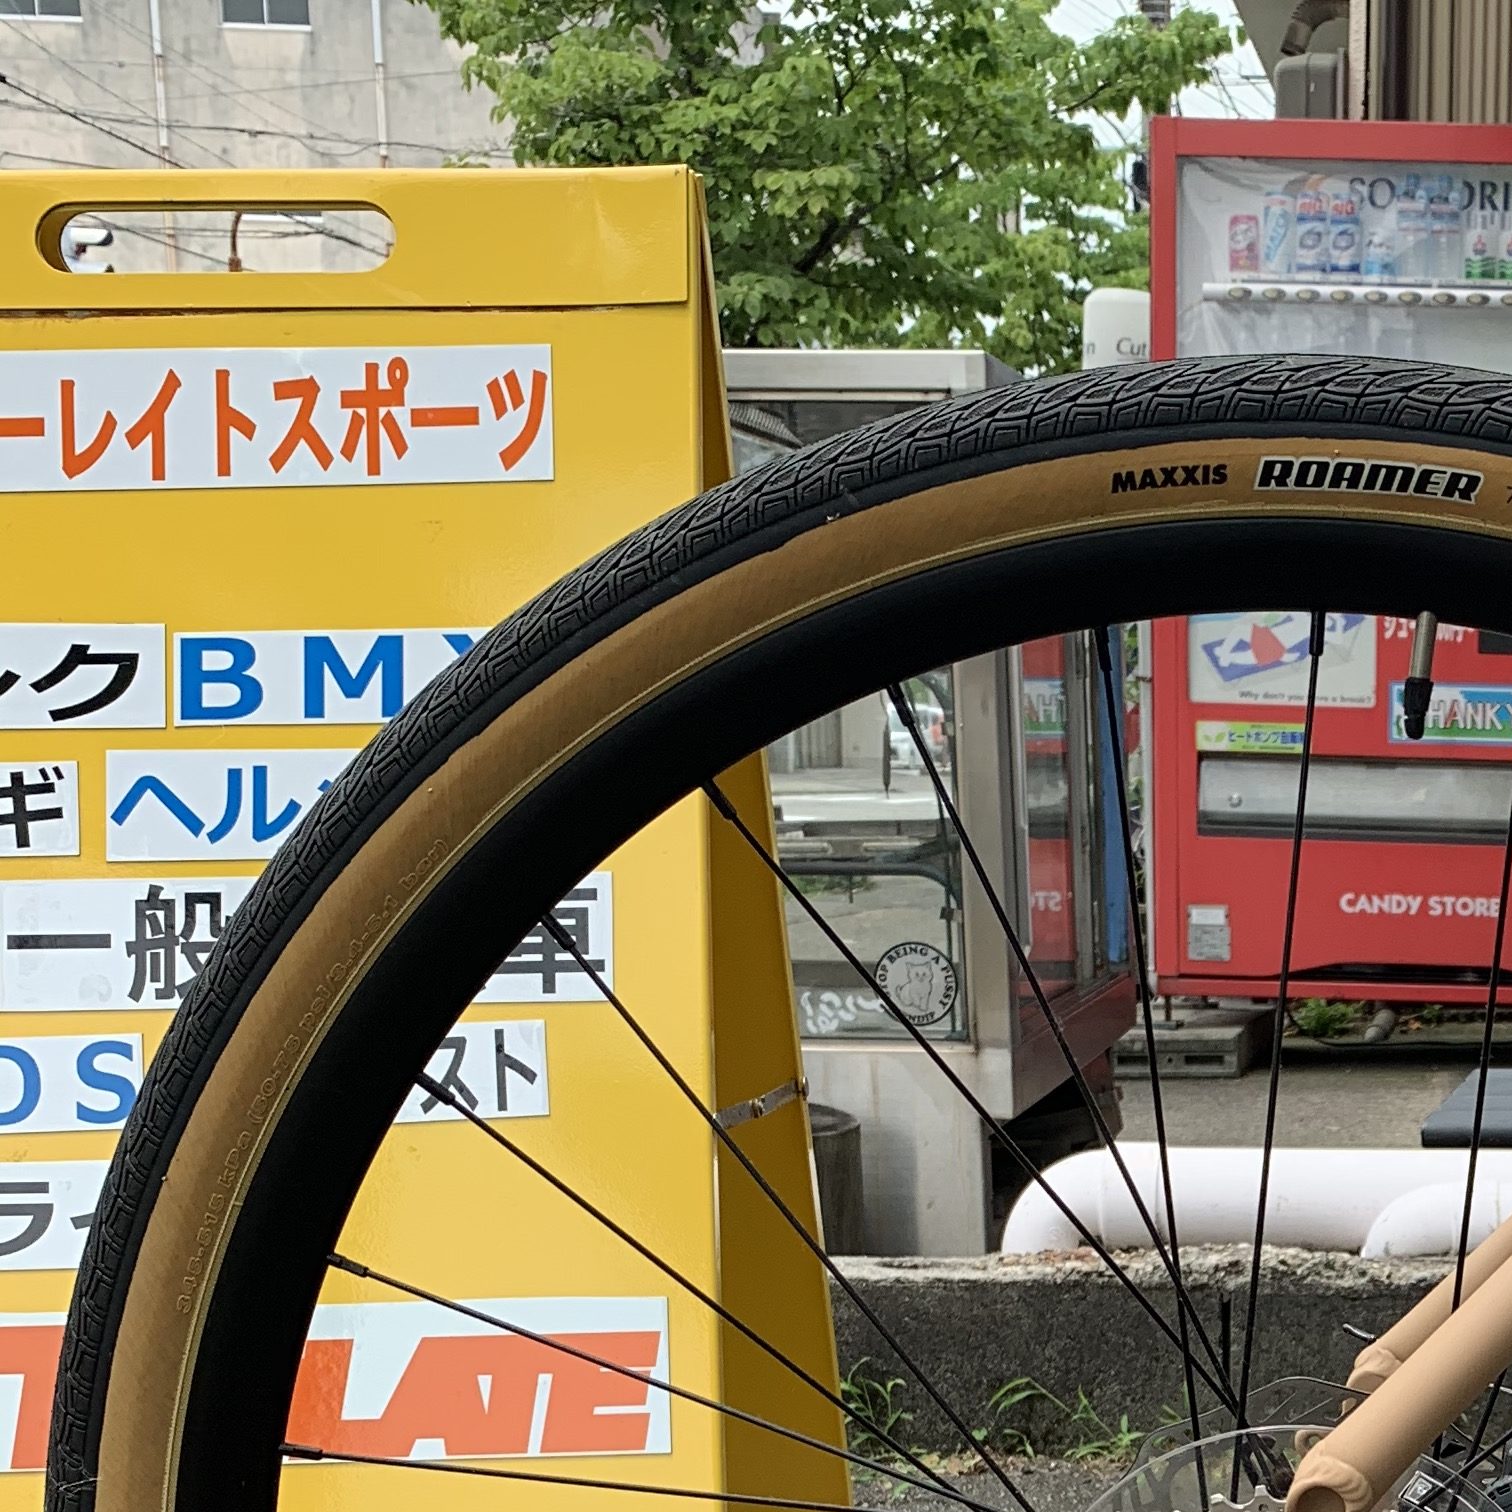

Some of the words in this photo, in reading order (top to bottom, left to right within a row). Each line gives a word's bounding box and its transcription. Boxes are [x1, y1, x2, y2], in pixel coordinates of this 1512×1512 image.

[1111, 463, 1228, 494] MAXXIS
[1255, 456, 1484, 504] ROAMER
[180, 633, 475, 721] BM
[110, 764, 331, 846] ヘル
[1339, 892, 1421, 916] CANDY
[1428, 896, 1501, 918] STORE
[886, 945, 929, 964] BEING
[931, 955, 941, 965] A
